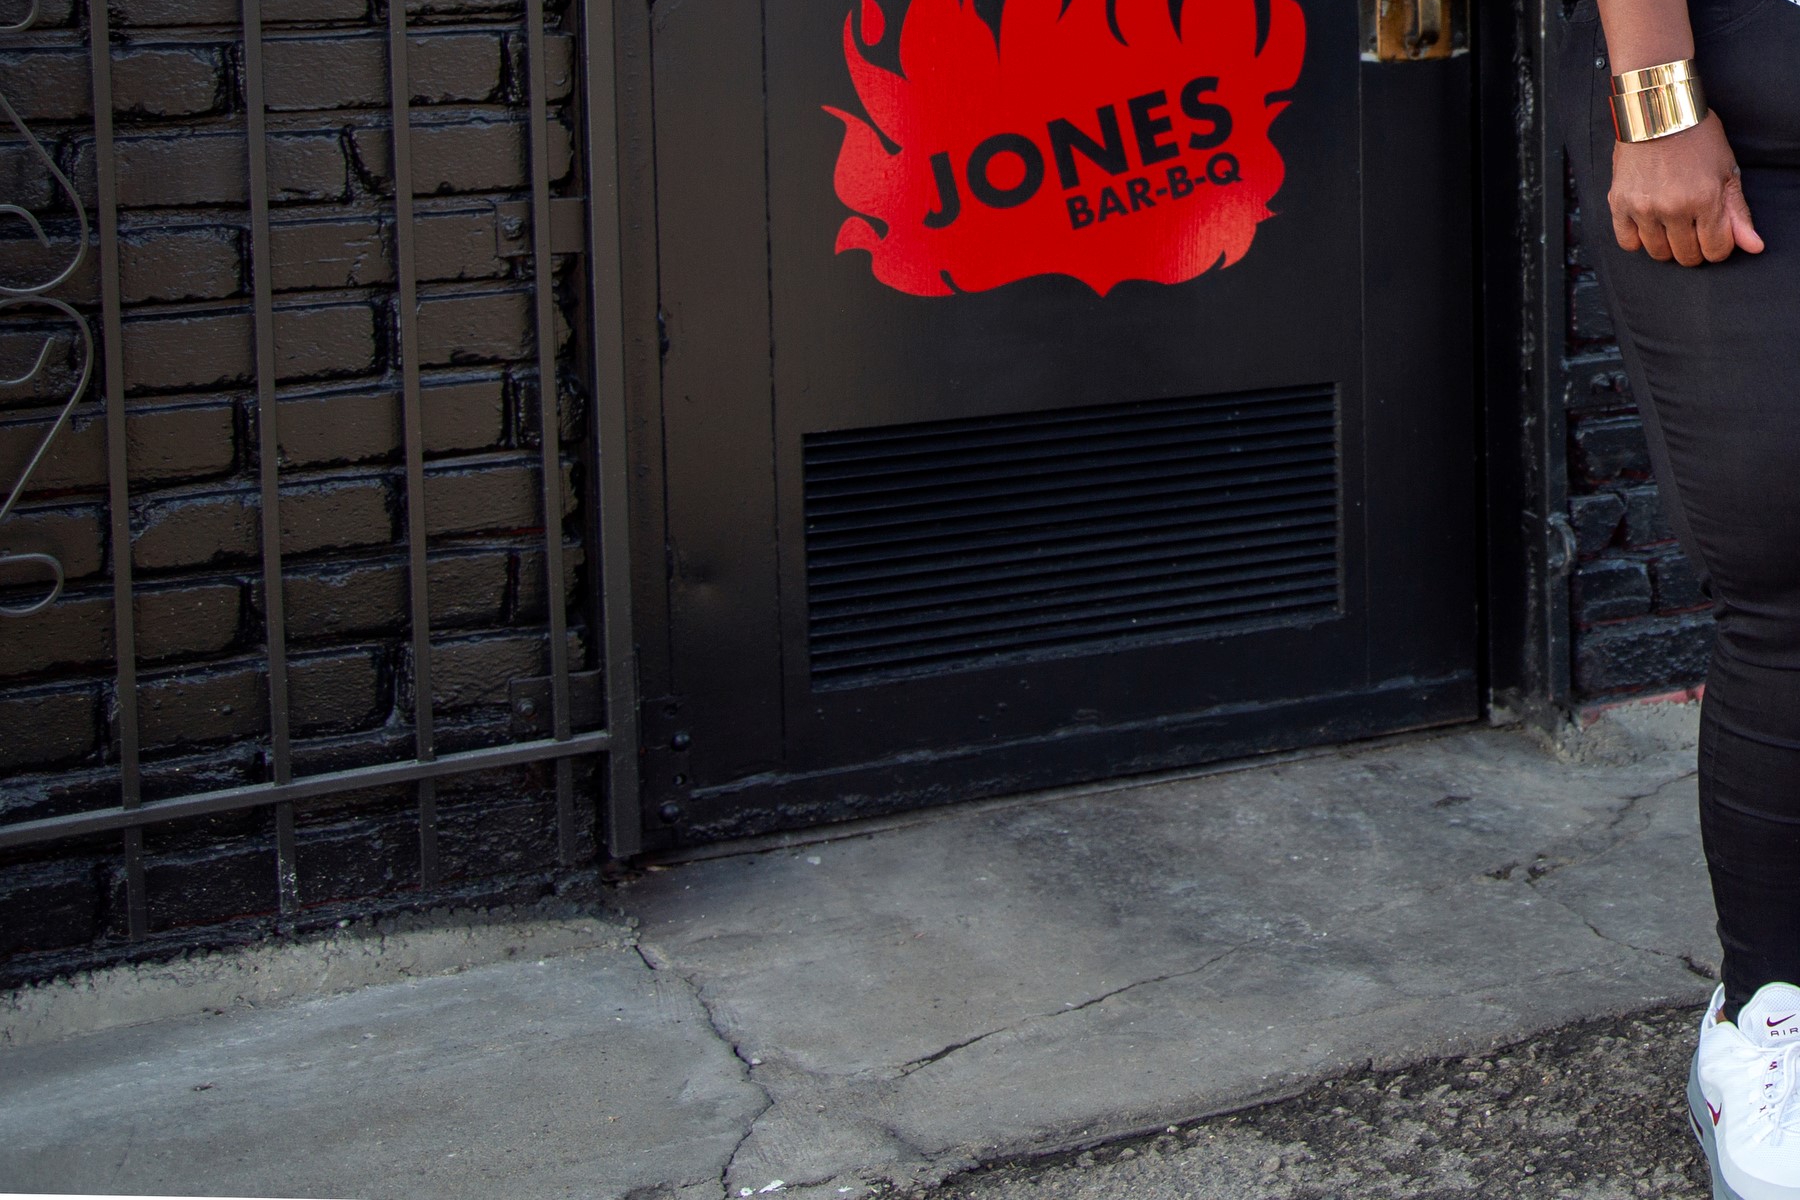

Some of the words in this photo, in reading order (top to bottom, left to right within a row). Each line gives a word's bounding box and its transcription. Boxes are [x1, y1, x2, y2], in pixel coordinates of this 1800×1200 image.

[922, 76, 1234, 230] JONES
[1066, 152, 1243, 230] BAR-B-Q
[1770, 1027, 1799, 1037] AIR
[1759, 1060, 1778, 1114] MAX
